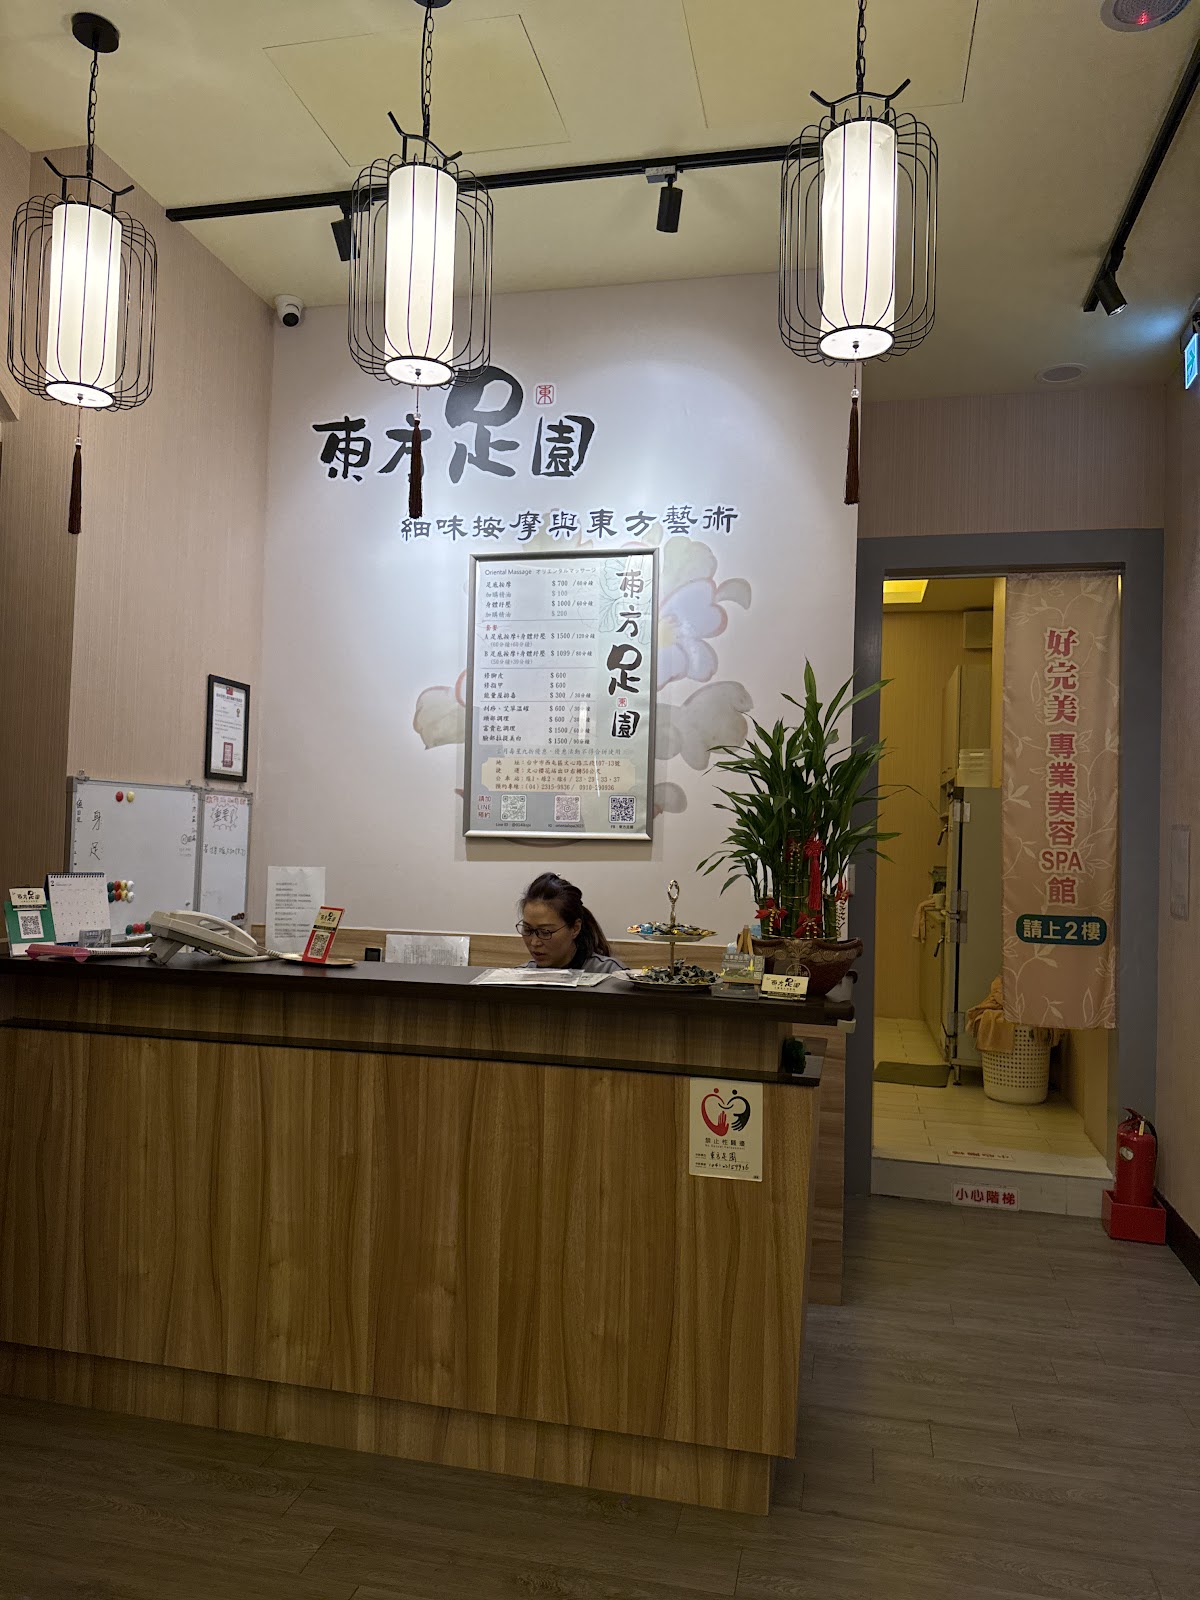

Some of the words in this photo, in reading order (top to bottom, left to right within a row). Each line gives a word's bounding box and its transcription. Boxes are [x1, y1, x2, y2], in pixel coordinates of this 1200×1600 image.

[401, 504, 738, 541] 細味按摩與東方藝術
[606, 569, 645, 738] 東方足園
[1045, 628, 1078, 724] 好完美
[1021, 919, 1101, 940] 請上2樓
[956, 1187, 1016, 1206] 小心階梯
